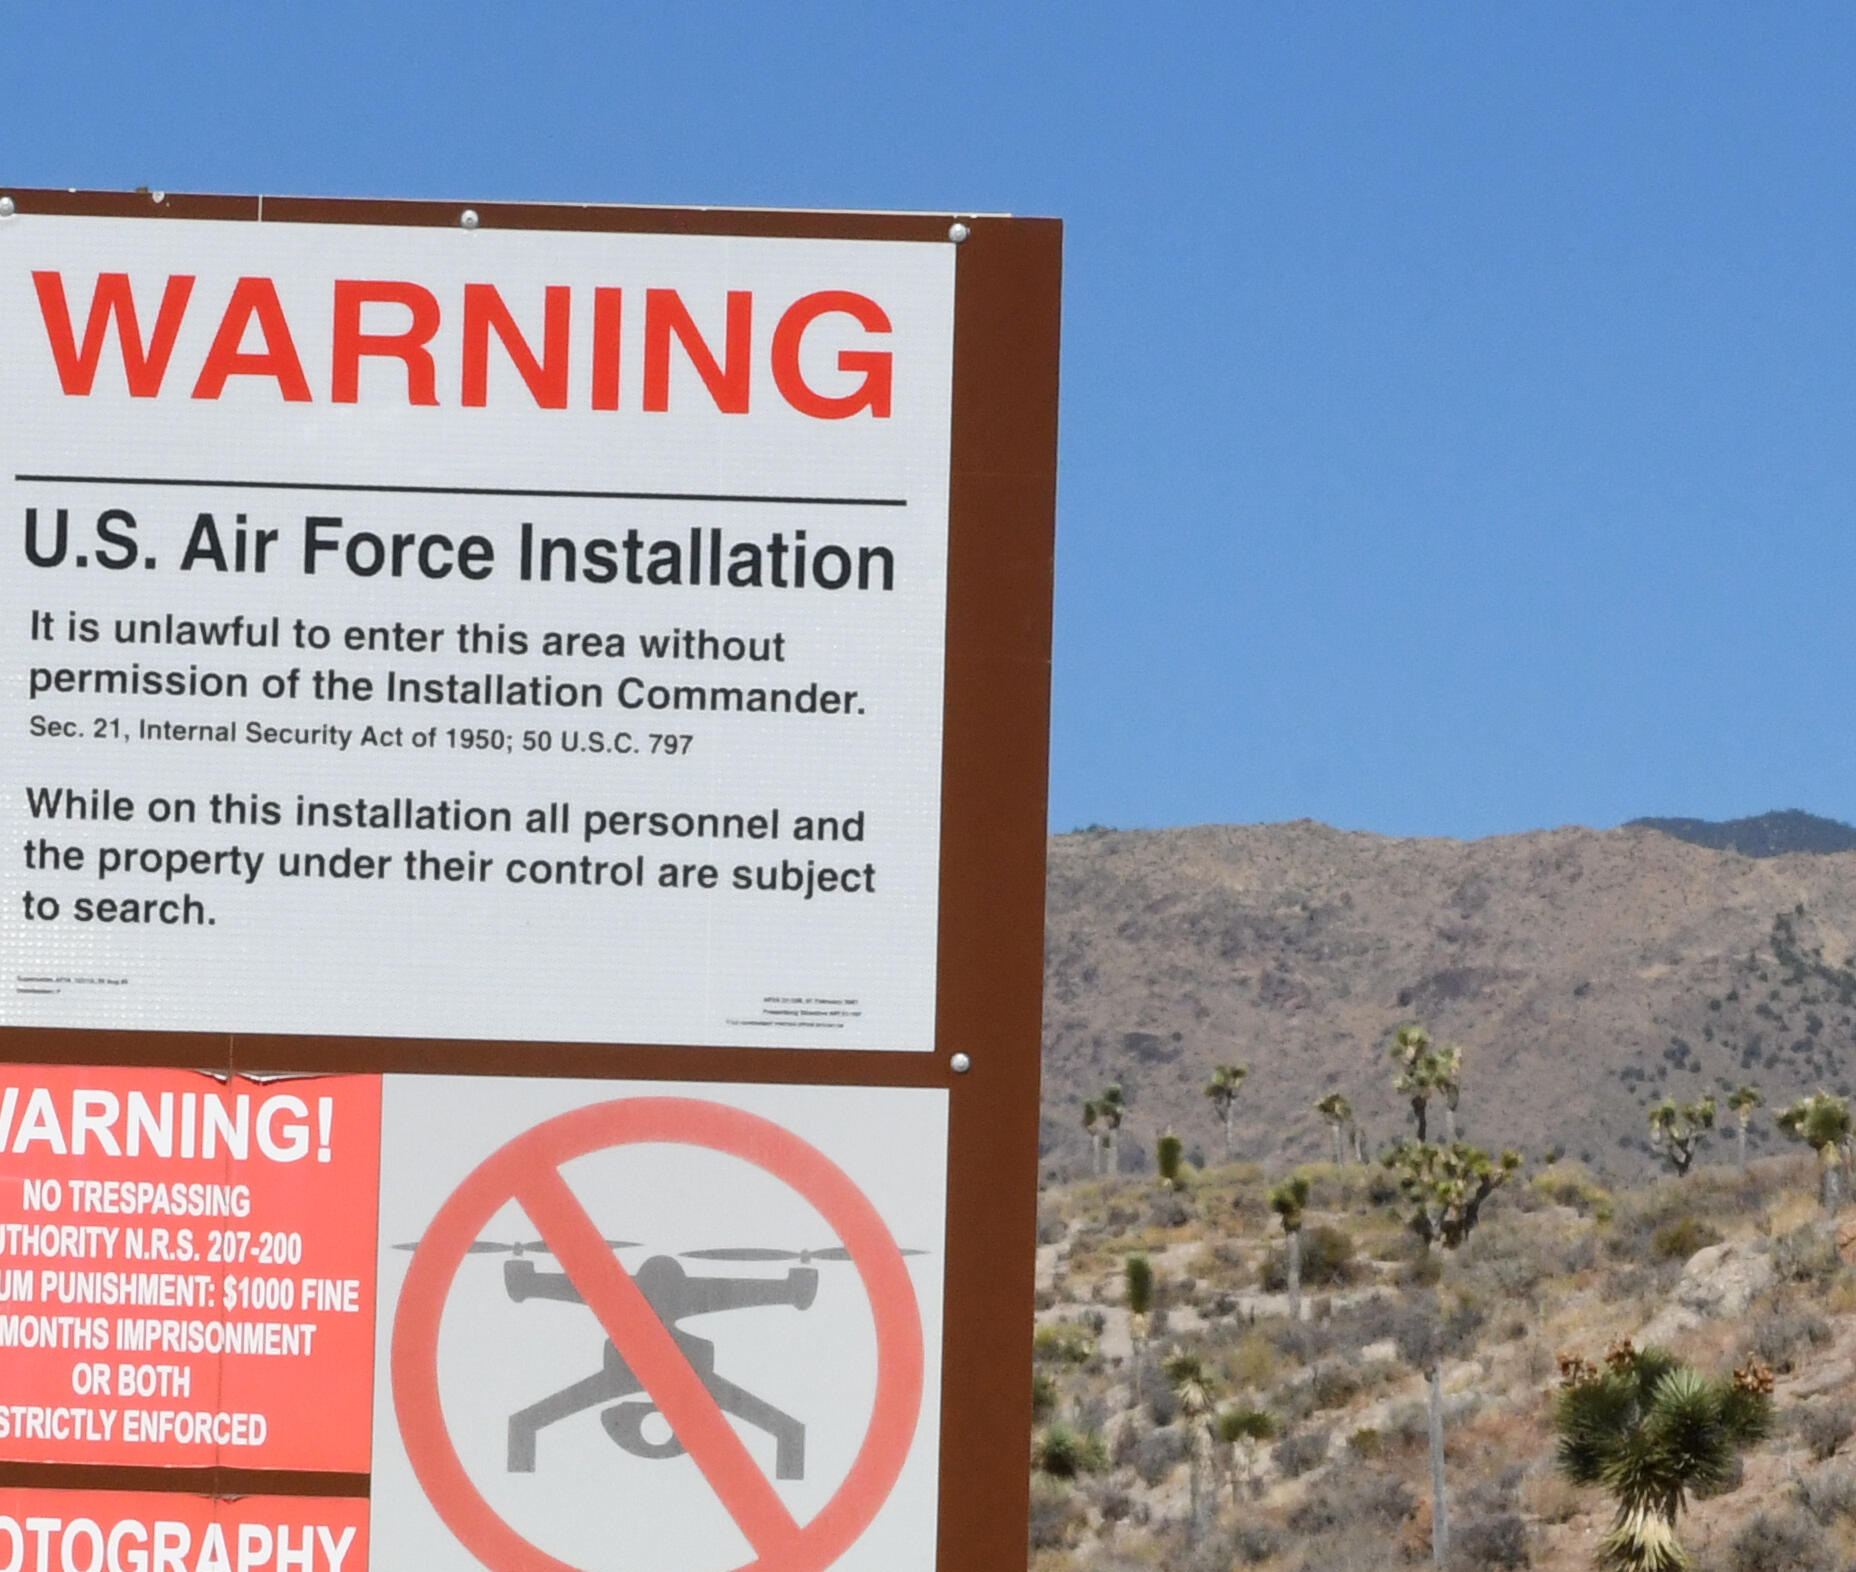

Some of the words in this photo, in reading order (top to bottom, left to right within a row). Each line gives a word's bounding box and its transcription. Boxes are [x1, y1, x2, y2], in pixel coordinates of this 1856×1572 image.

[32, 271, 892, 419] WARNING
[25, 509, 155, 569] U.S.
[180, 514, 278, 572] Air
[305, 517, 494, 580] Force
[521, 523, 893, 590] Installation
[32, 610, 54, 640] It
[69, 611, 99, 642] is
[115, 614, 278, 647] unlawful
[293, 619, 330, 649] to
[345, 623, 444, 652] enter
[457, 623, 528, 655] this
[543, 633, 624, 657] area
[640, 628, 785, 661] without
[30, 665, 246, 699] permission
[263, 668, 300, 698] of
[313, 669, 373, 701] the
[388, 671, 602, 707] Installation
[618, 677, 864, 714] Commander.
[30, 715, 83, 737] Sec.
[94, 718, 129, 742] 21,
[140, 719, 236, 741] Internal
[246, 722, 352, 751] Security
[361, 726, 403, 747] Act
[412, 727, 436, 747] of
[447, 729, 512, 753] 1950;
[523, 731, 551, 751] 50
[562, 731, 638, 753] U.S.C.
[649, 734, 693, 754] 797
[26, 788, 134, 821] While
[149, 799, 195, 822] on
[210, 793, 281, 825] this
[297, 795, 510, 831] installation
[526, 803, 568, 833] all
[585, 809, 778, 842] personnel
[794, 811, 864, 841] and
[24, 839, 84, 870] the
[99, 846, 264, 884] property
[280, 848, 392, 878] under
[404, 850, 493, 881] their
[507, 856, 643, 886] control
[658, 864, 718, 888] are
[733, 860, 875, 899] subject
[23, 891, 59, 920] to
[74, 894, 215, 925] search.
[24, 1179, 61, 1211] NO
[69, 1180, 250, 1217] TRESPASSING
[126, 1228, 199, 1261] N.R.S.
[208, 1231, 301, 1264] 207-200
[41, 1271, 214, 1307] PUNISHMENT:
[223, 1275, 294, 1311] $1000
[302, 1279, 359, 1312] FINE
[0, 1315, 109, 1349] MONTHS
[117, 1319, 316, 1355] IMPRISONMENT
[72, 1363, 110, 1395] OR
[118, 1364, 190, 1397] BOTH
[124, 1410, 266, 1445] ENFORCED
